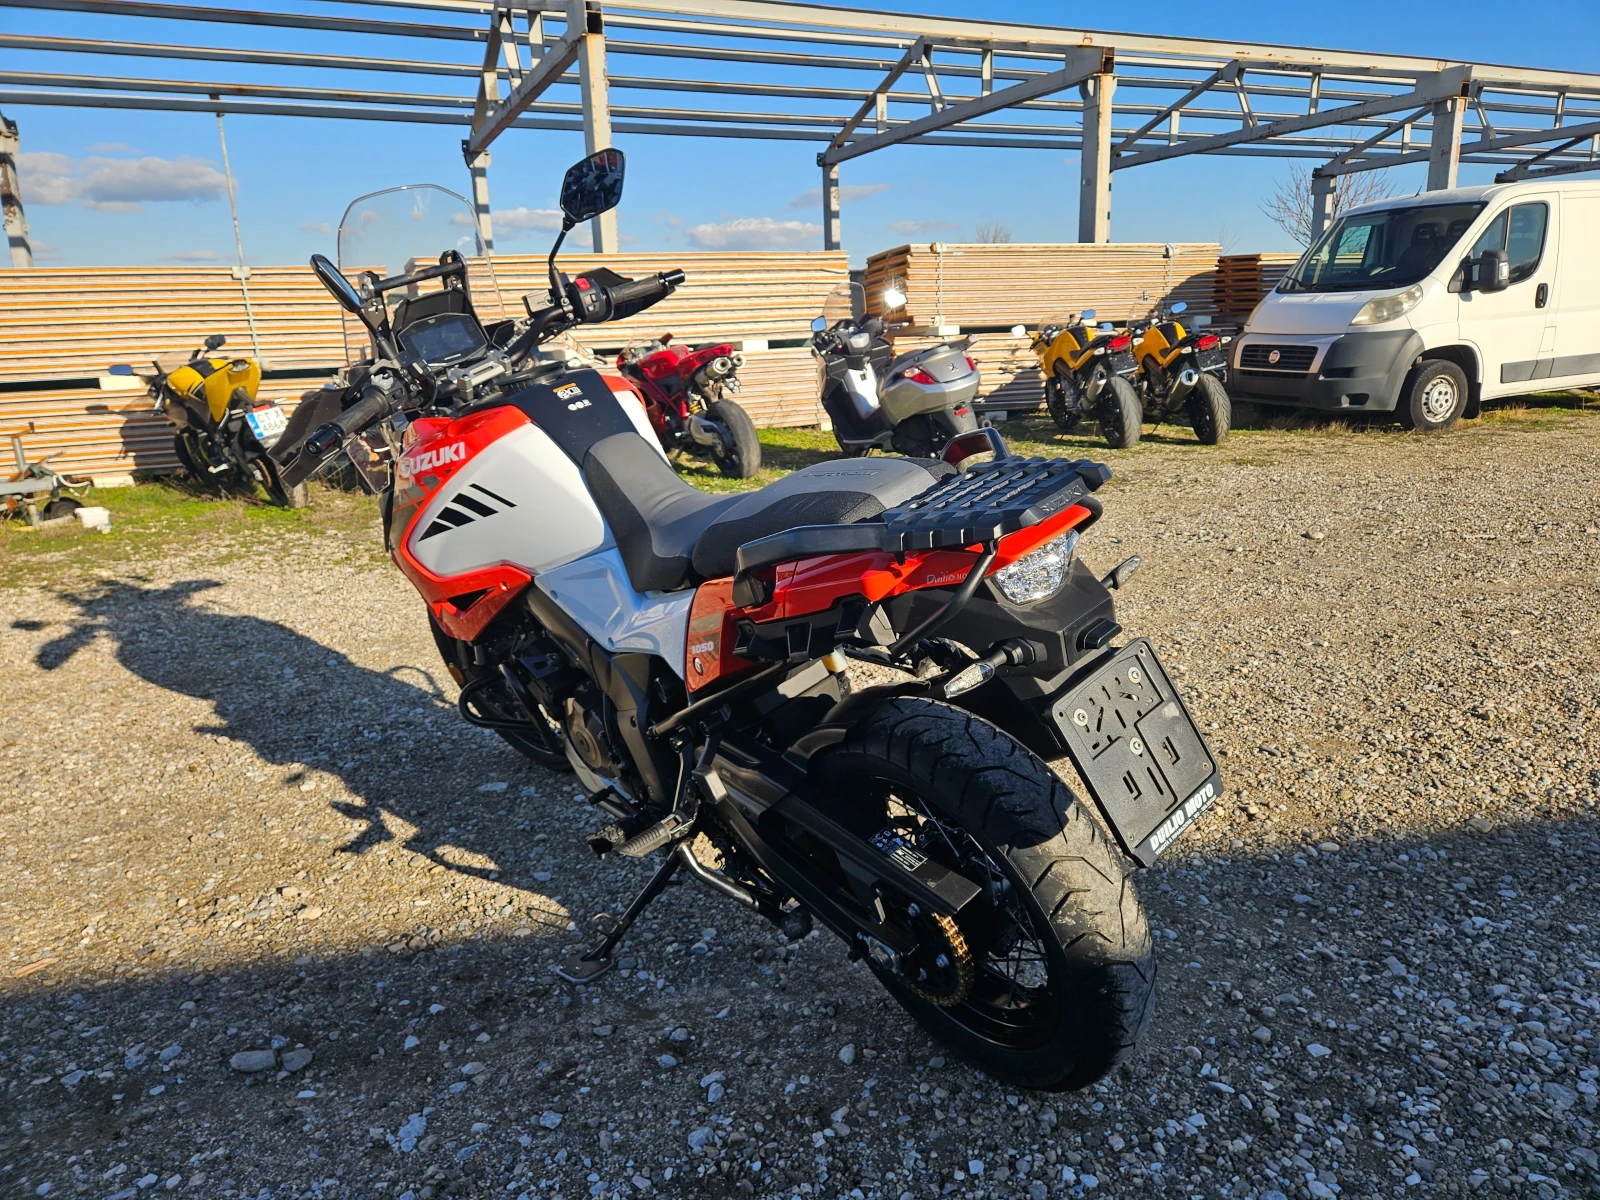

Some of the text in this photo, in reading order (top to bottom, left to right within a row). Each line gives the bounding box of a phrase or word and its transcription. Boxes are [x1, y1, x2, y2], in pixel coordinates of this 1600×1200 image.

[400, 441, 466, 478] SUZUKI
[691, 641, 714, 655] 1050
[1149, 810, 1185, 851] DUILIO
[1185, 783, 1214, 818] MOTO
